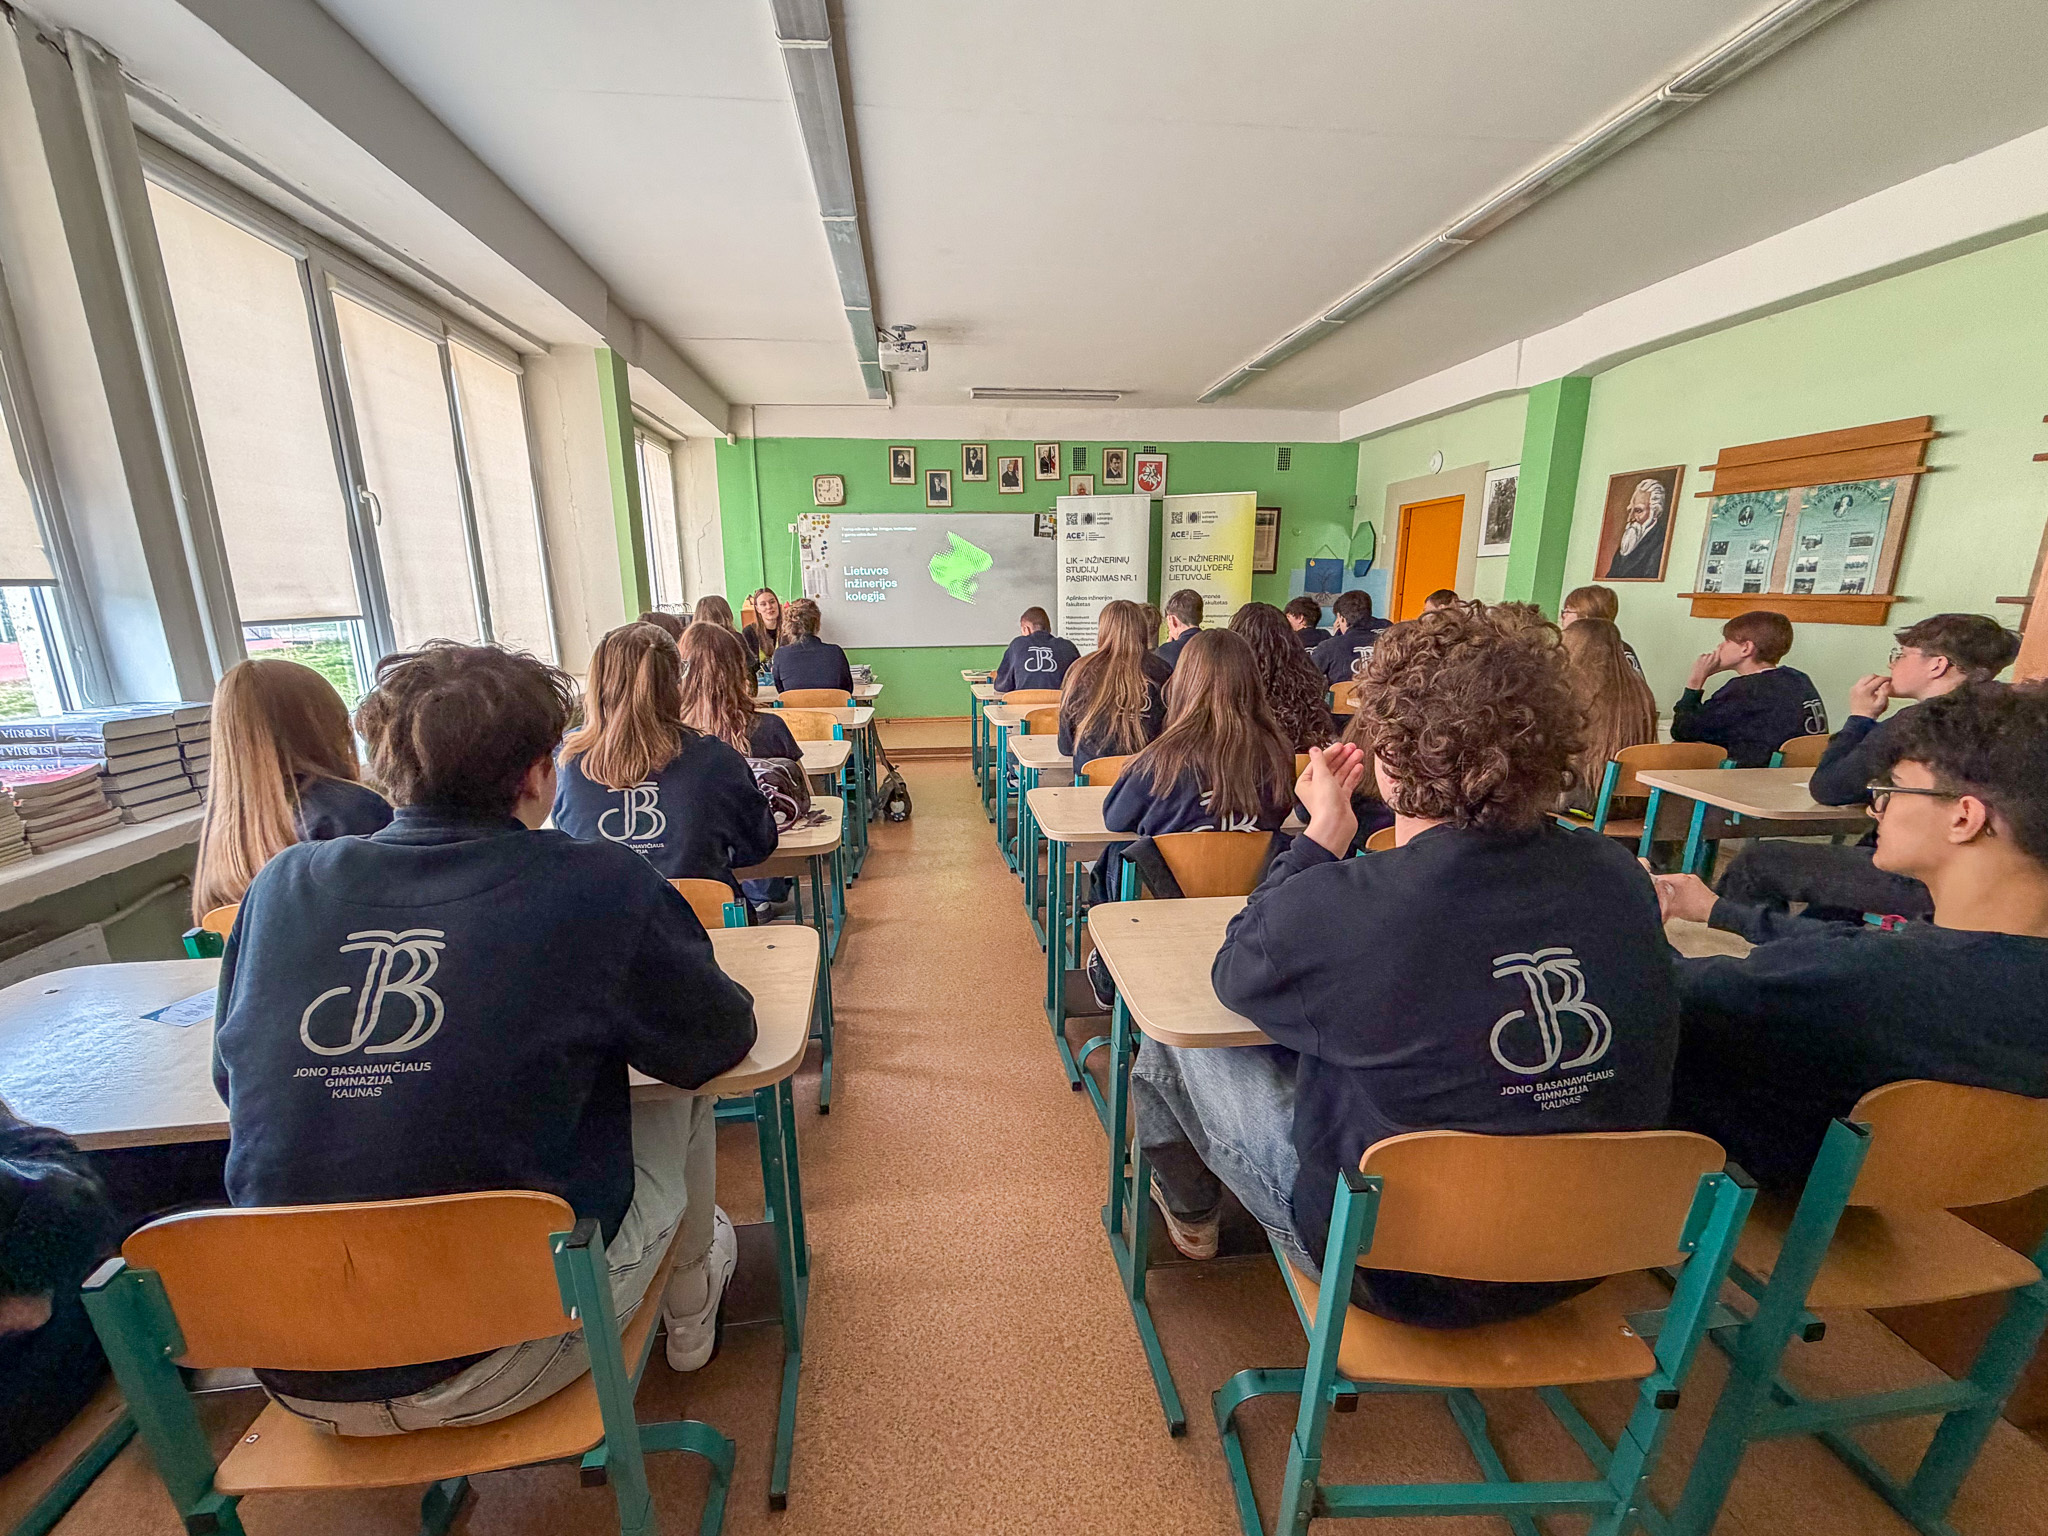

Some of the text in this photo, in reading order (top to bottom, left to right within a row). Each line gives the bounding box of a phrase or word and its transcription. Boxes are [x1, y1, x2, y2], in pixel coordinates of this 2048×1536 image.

[843, 566, 889, 576] Lietuvos
[1066, 566, 1099, 574] STUDIJŲ
[1169, 564, 1202, 573] STUDIJŲ
[1169, 573, 1212, 581] LIETUVOJE
[844, 578, 898, 590] inžinerijos
[845, 590, 886, 603] kolegija
[293, 1061, 432, 1078] JONO BASANAVIČIAUS
[324, 1076, 393, 1088] GIMNAZIJA
[1500, 1069, 1615, 1096] JONO BASANAVIČIAUS
[331, 1087, 383, 1099] KAUNAS
[1533, 1084, 1590, 1102] GIMNAZIJA
[1541, 1095, 1582, 1111] KAUNAS
